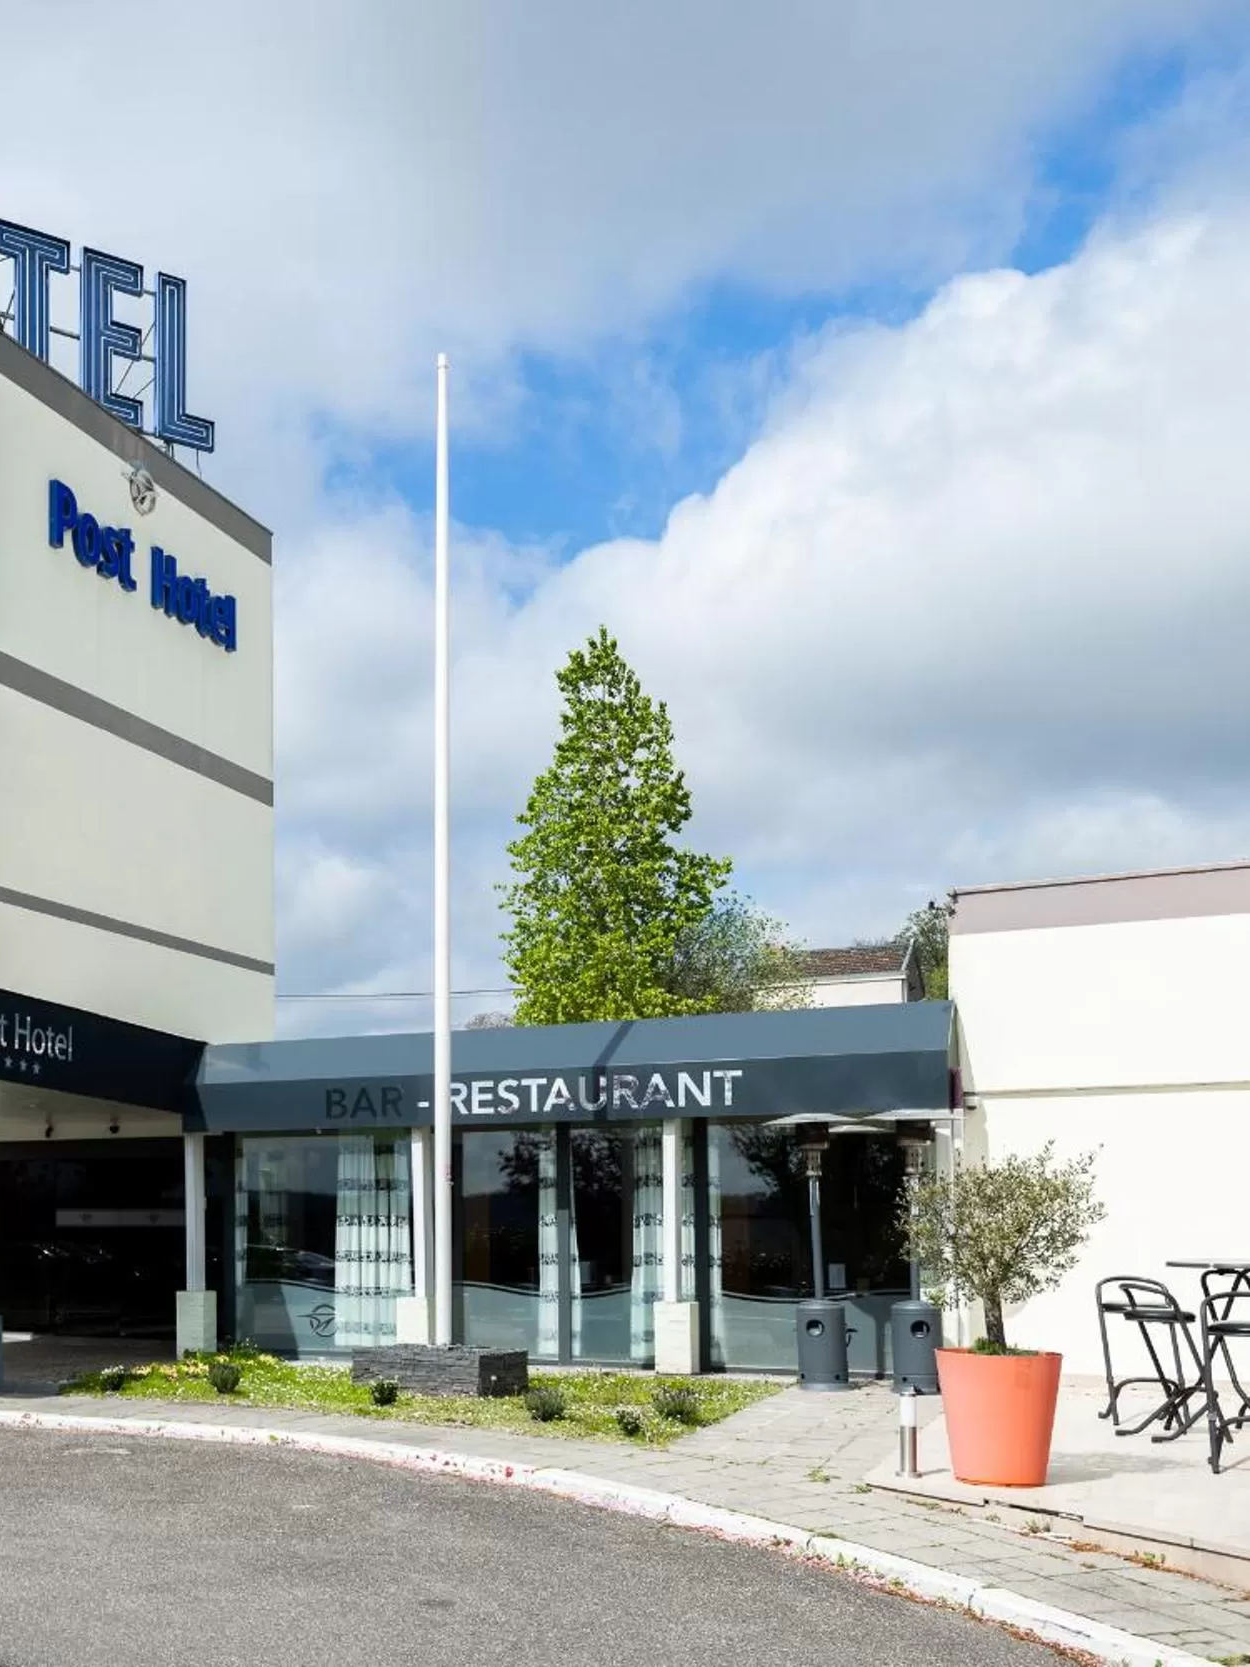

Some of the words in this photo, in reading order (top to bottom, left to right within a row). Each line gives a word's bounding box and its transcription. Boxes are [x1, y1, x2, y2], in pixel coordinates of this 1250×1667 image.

[48, 479, 137, 592] Post
[150, 545, 238, 652] Hotel
[14, 1012, 73, 1062] Hotel
[325, 1086, 404, 1120] BAR
[449, 1069, 743, 1115] RESTAURANT
